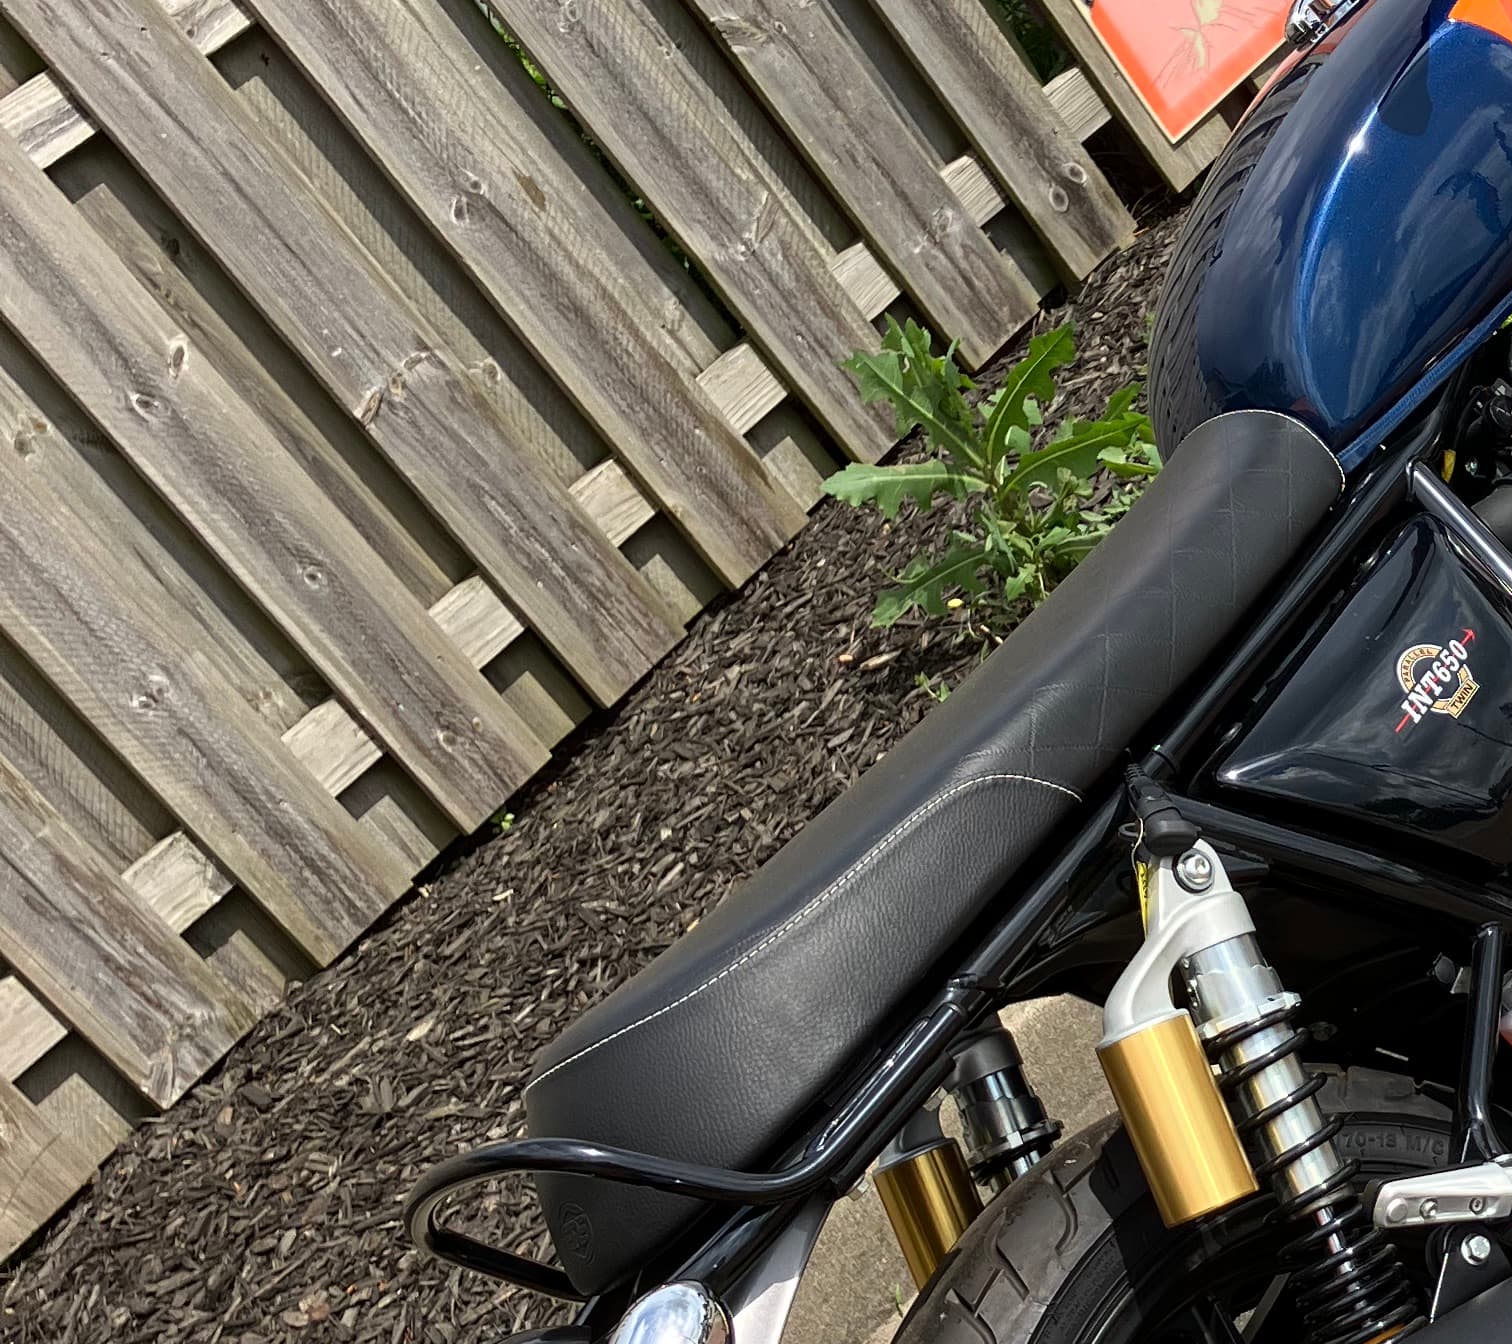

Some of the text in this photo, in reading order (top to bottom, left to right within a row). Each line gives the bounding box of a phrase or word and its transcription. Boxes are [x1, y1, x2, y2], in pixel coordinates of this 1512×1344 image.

[1400, 639, 1468, 724] INT650
[1401, 646, 1434, 684] PARALLEL
[1450, 682, 1474, 710] TWIN
